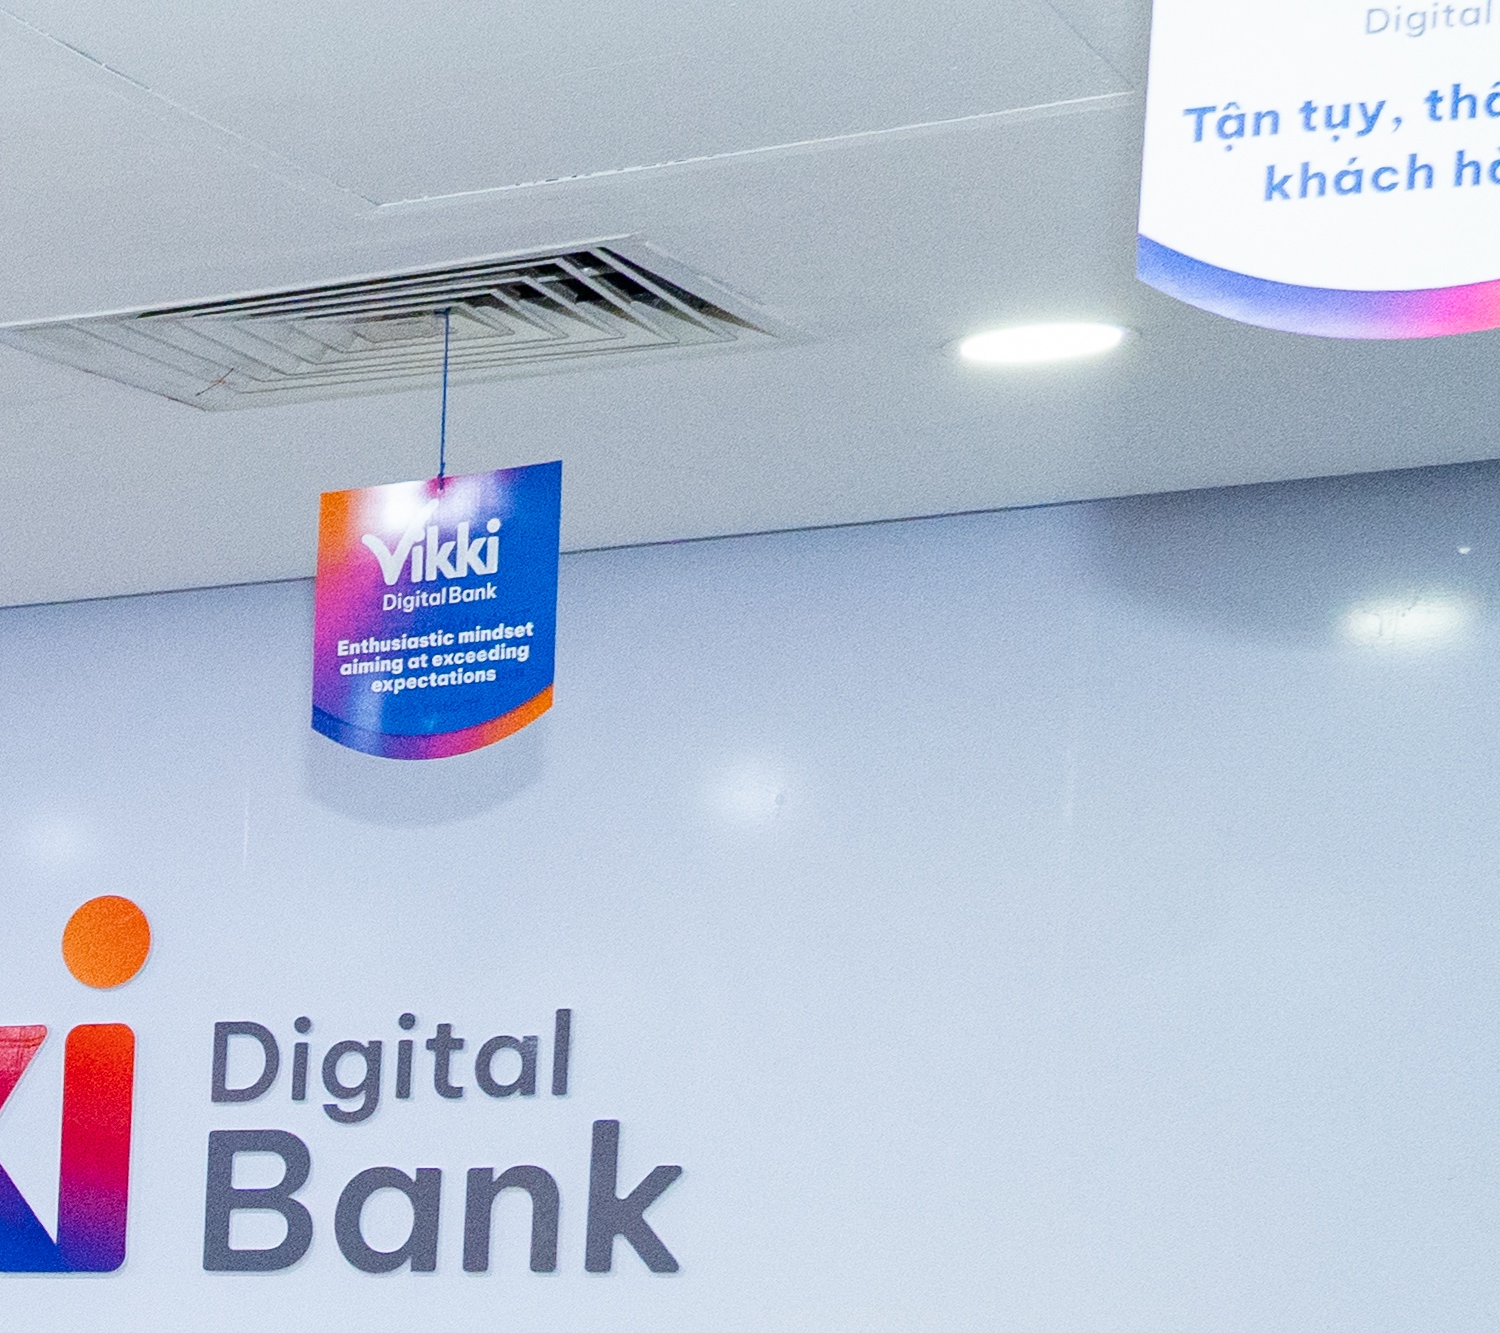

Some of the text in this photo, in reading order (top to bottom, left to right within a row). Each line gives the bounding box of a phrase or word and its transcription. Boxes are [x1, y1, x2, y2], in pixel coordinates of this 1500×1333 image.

[1182, 101, 1281, 152] Tận
[1299, 99, 1403, 142] tụy,
[1263, 156, 1435, 202] khách
[361, 499, 501, 586] Vikki
[336, 620, 534, 657] Enthusiastic mindset
[339, 642, 531, 676] aiming at exceeding
[371, 667, 497, 695] expectations
[209, 1006, 573, 1125] Digital
[201, 1119, 685, 1275] Bank
